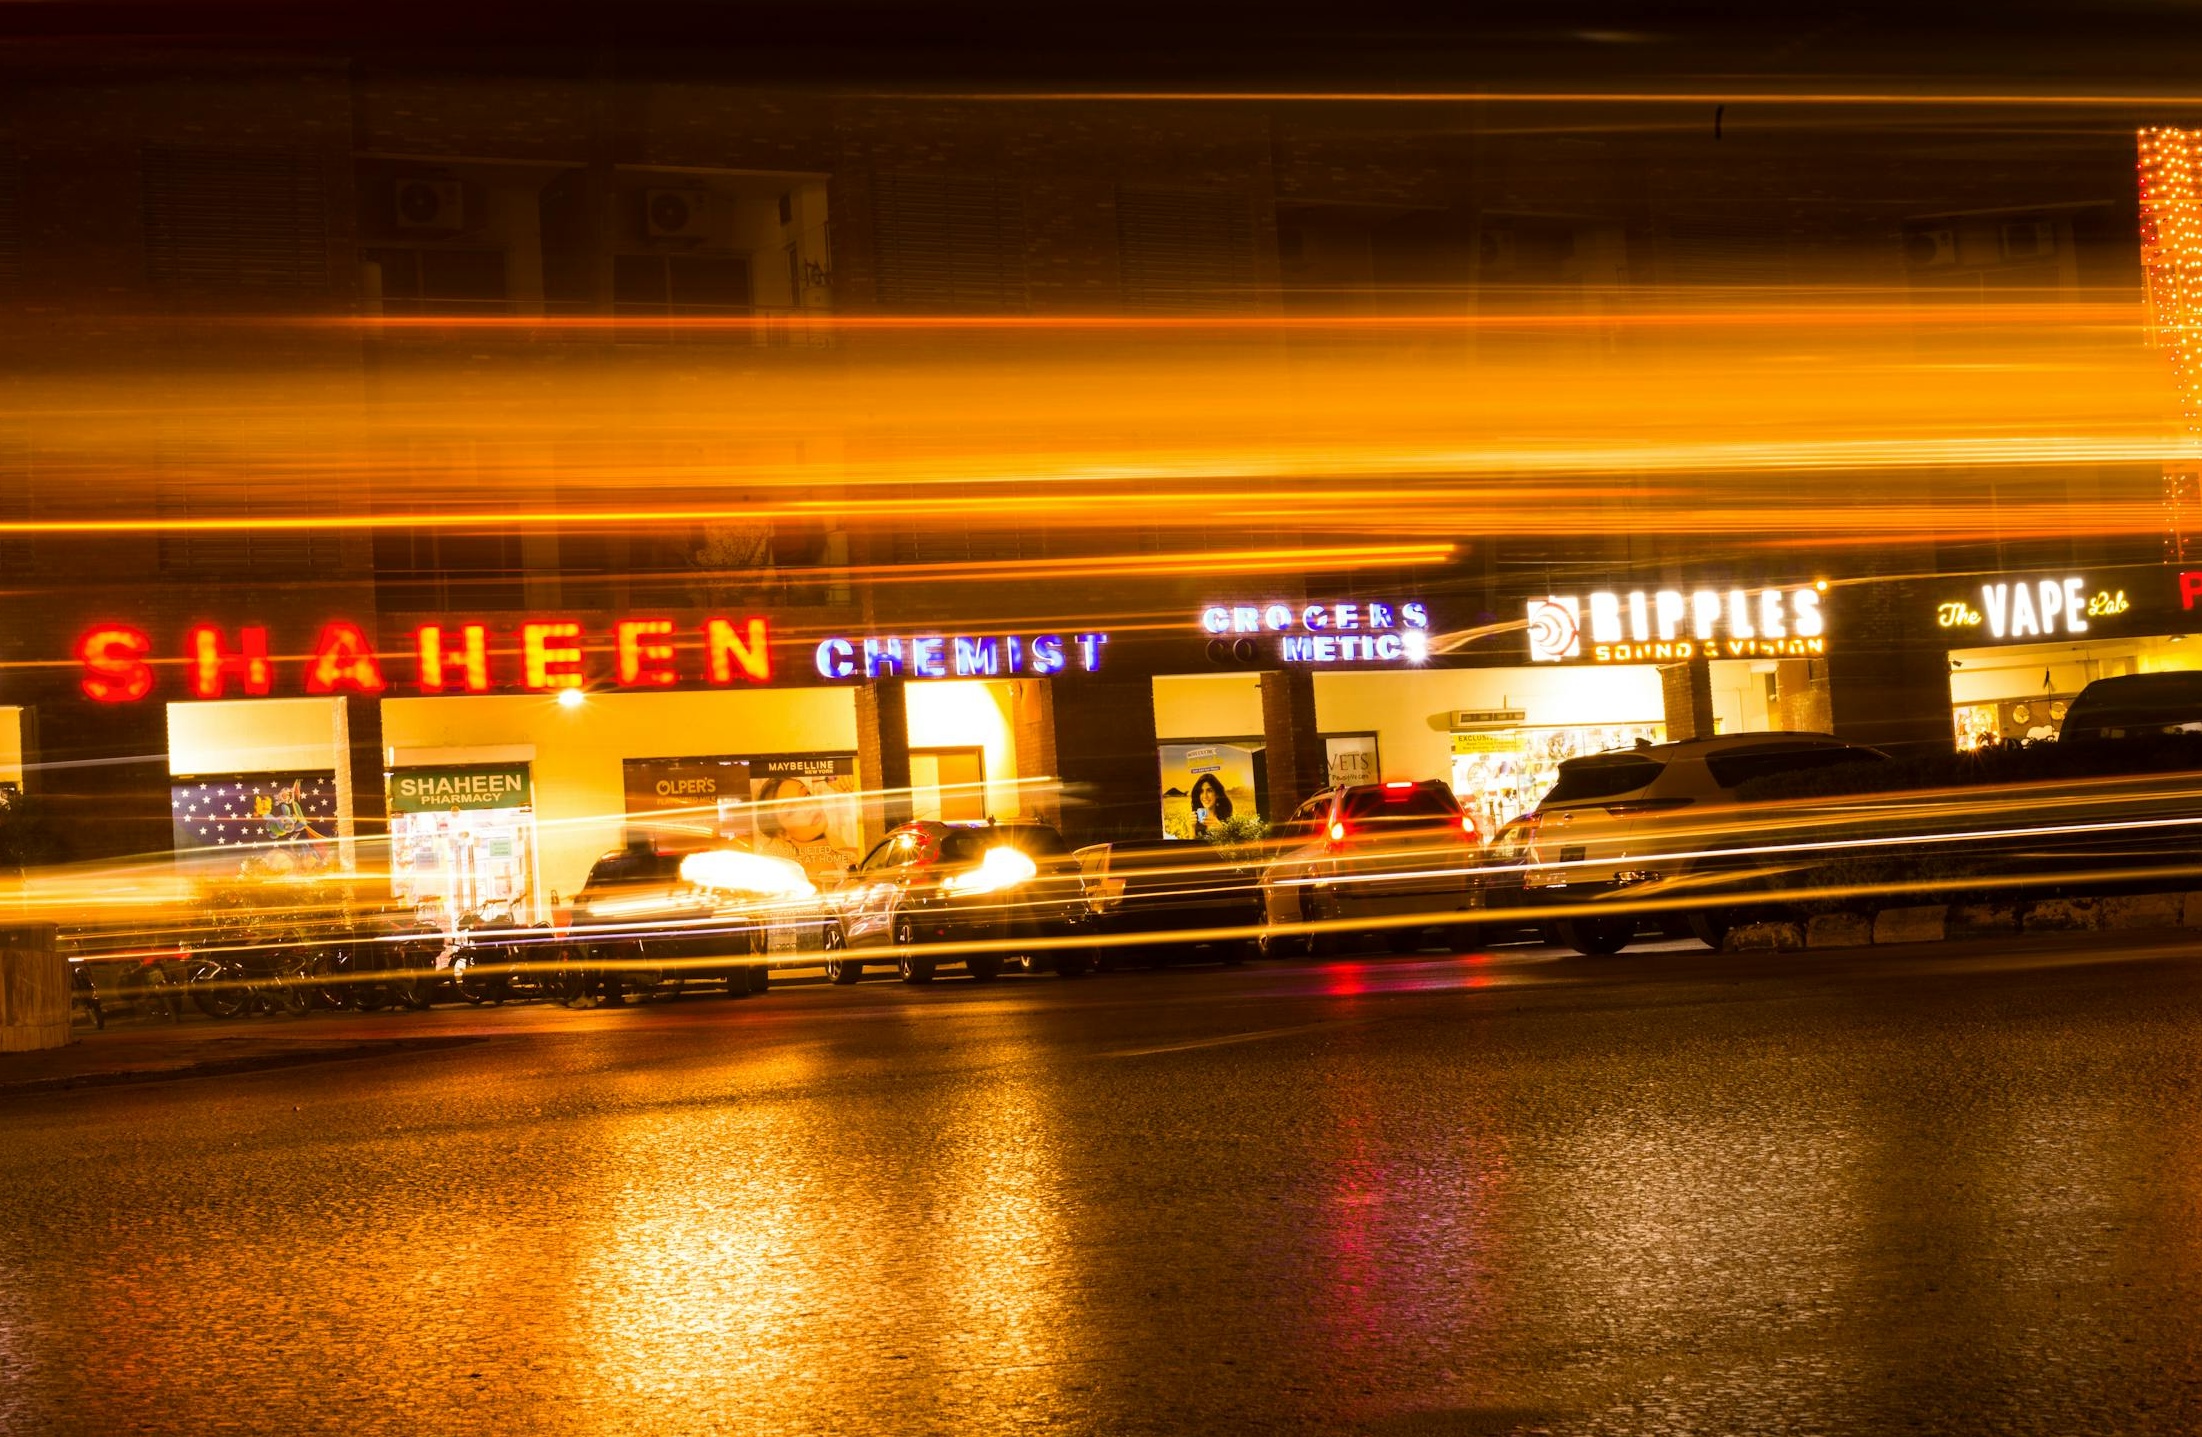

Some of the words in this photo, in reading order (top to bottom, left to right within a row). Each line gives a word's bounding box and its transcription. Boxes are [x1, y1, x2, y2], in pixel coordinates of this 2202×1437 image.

[1589, 589, 1824, 642] RIPPLES
[1938, 603, 1981, 627] The
[1983, 578, 2088, 638] VAPE
[2088, 590, 2129, 616] Lab
[78, 615, 773, 702] SHAHEEN
[816, 634, 1108, 678] CHEMIST
[1595, 641, 1693, 661] SOUND
[1728, 638, 1825, 657] VISION
[768, 760, 835, 772] MAYBELLINE
[400, 774, 522, 796] SHAHEEN
[656, 777, 717, 796] OLPER'S
[421, 793, 502, 805] PHARMACY
